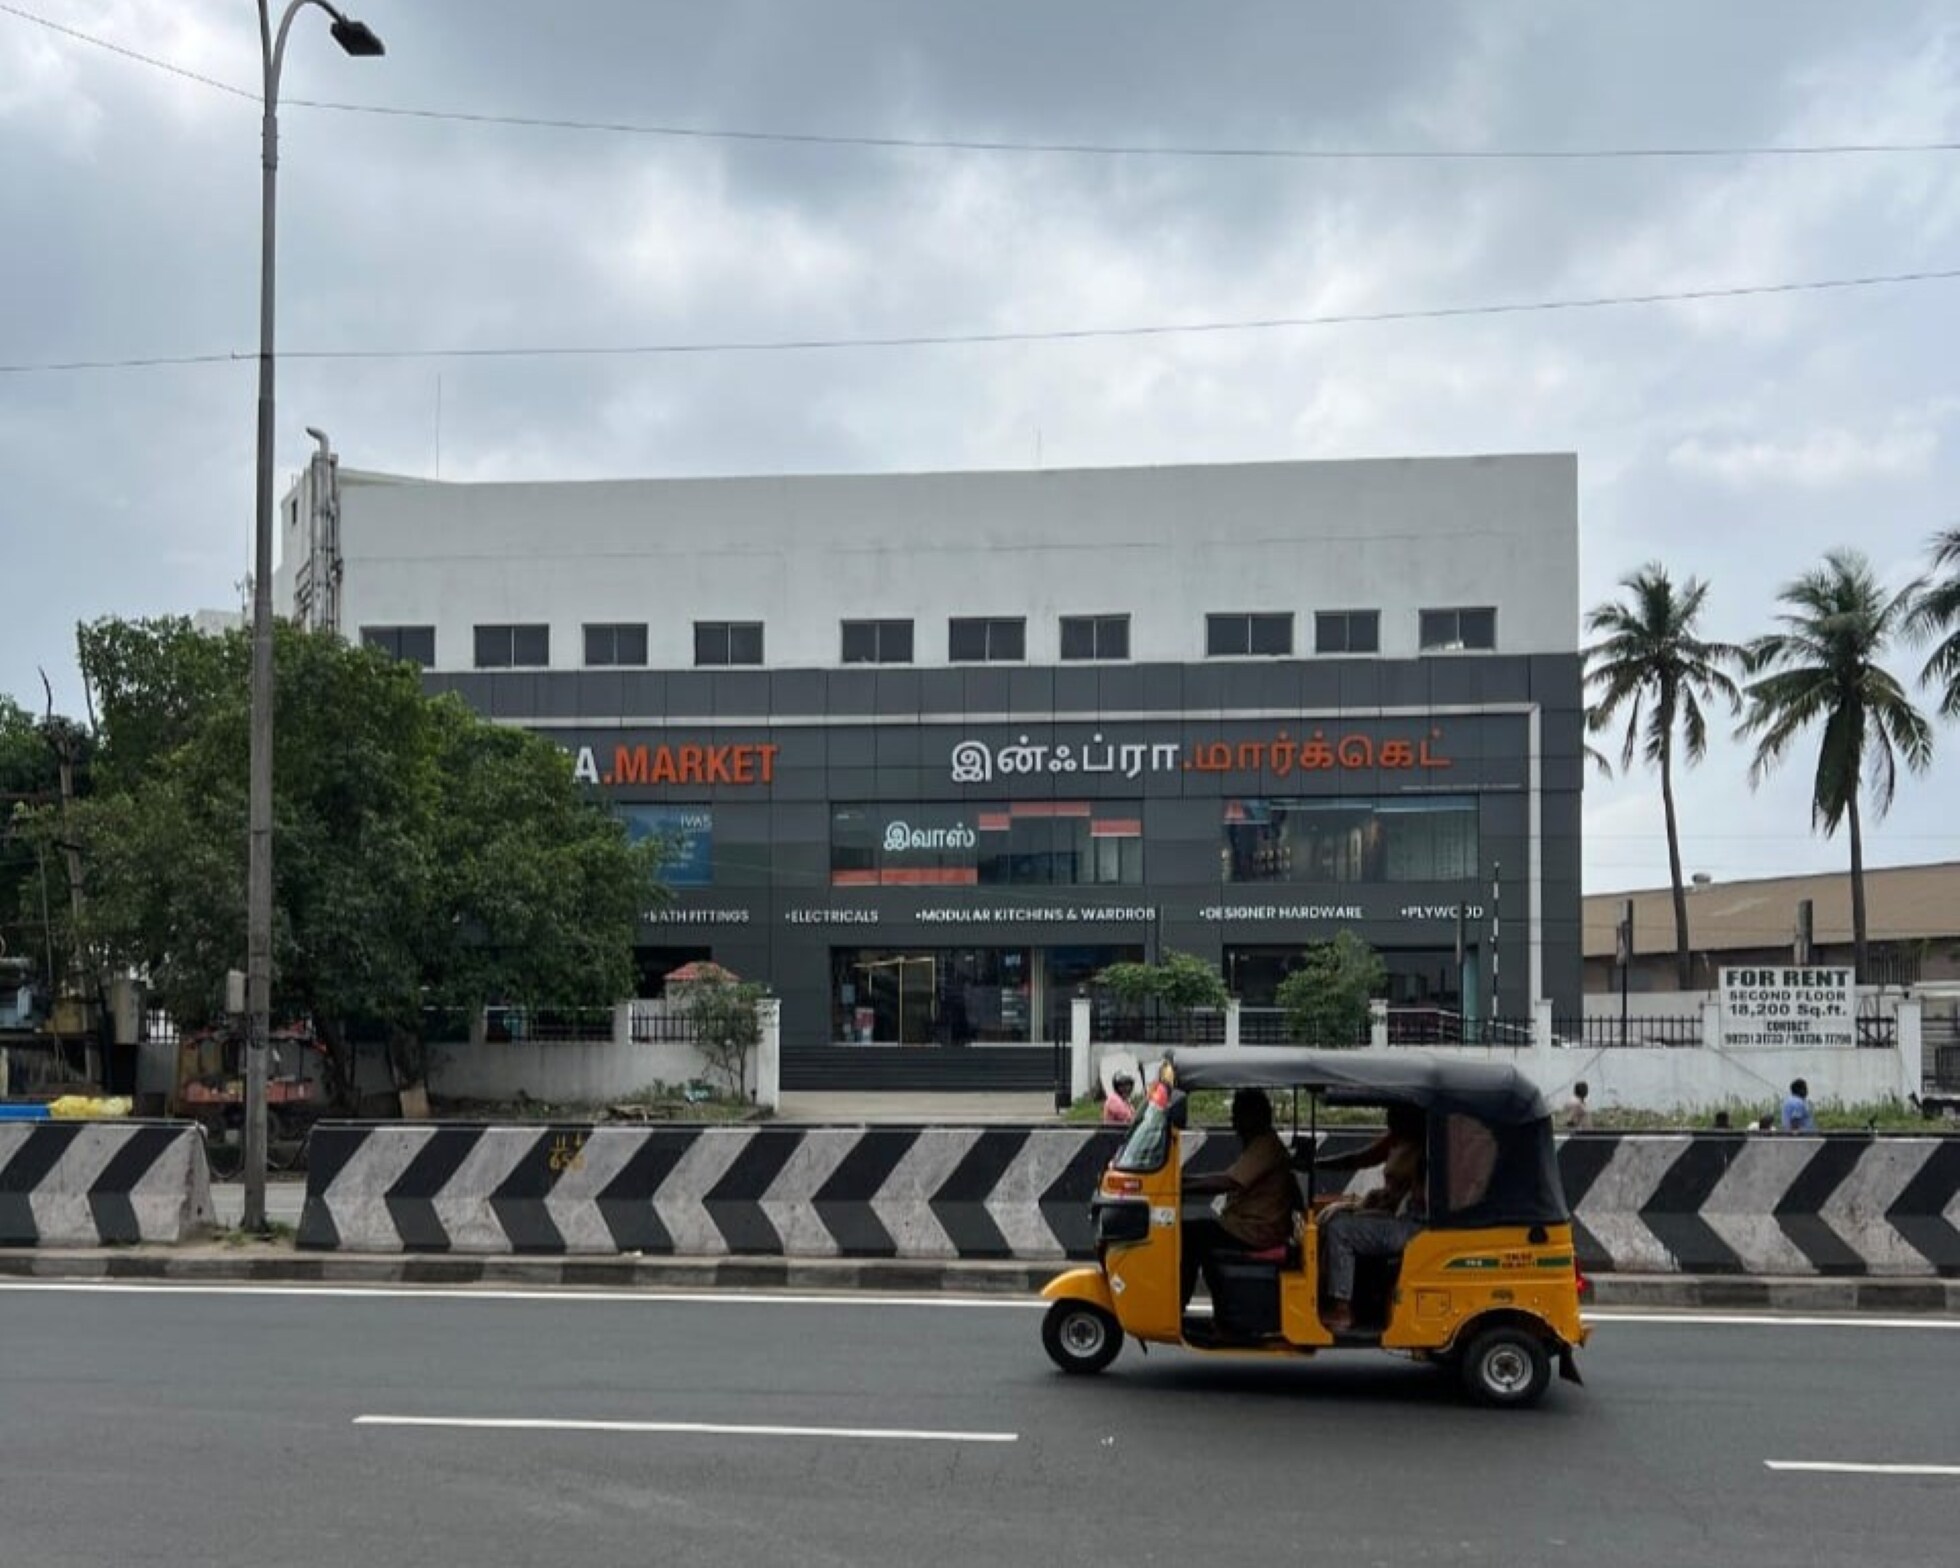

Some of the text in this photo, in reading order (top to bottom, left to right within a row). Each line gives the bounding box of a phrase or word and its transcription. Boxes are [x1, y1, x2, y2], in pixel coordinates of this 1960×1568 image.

[556, 744, 778, 785] A.MARKET
[883, 821, 976, 851] இவாஸ்
[689, 909, 749, 922] FITTINGS
[791, 908, 878, 922] ELECTRICALS
[921, 906, 1156, 921] MODULAR KITCHENS & WARDROB
[1205, 905, 1363, 920] DESIGNER HARDWARE
[1726, 970, 1849, 987] FOR RENT
[1730, 991, 1846, 1001] SECOND FLOOR
[1730, 1003, 1791, 1017] 18,200
[1766, 1021, 1809, 1032] CONTACT
